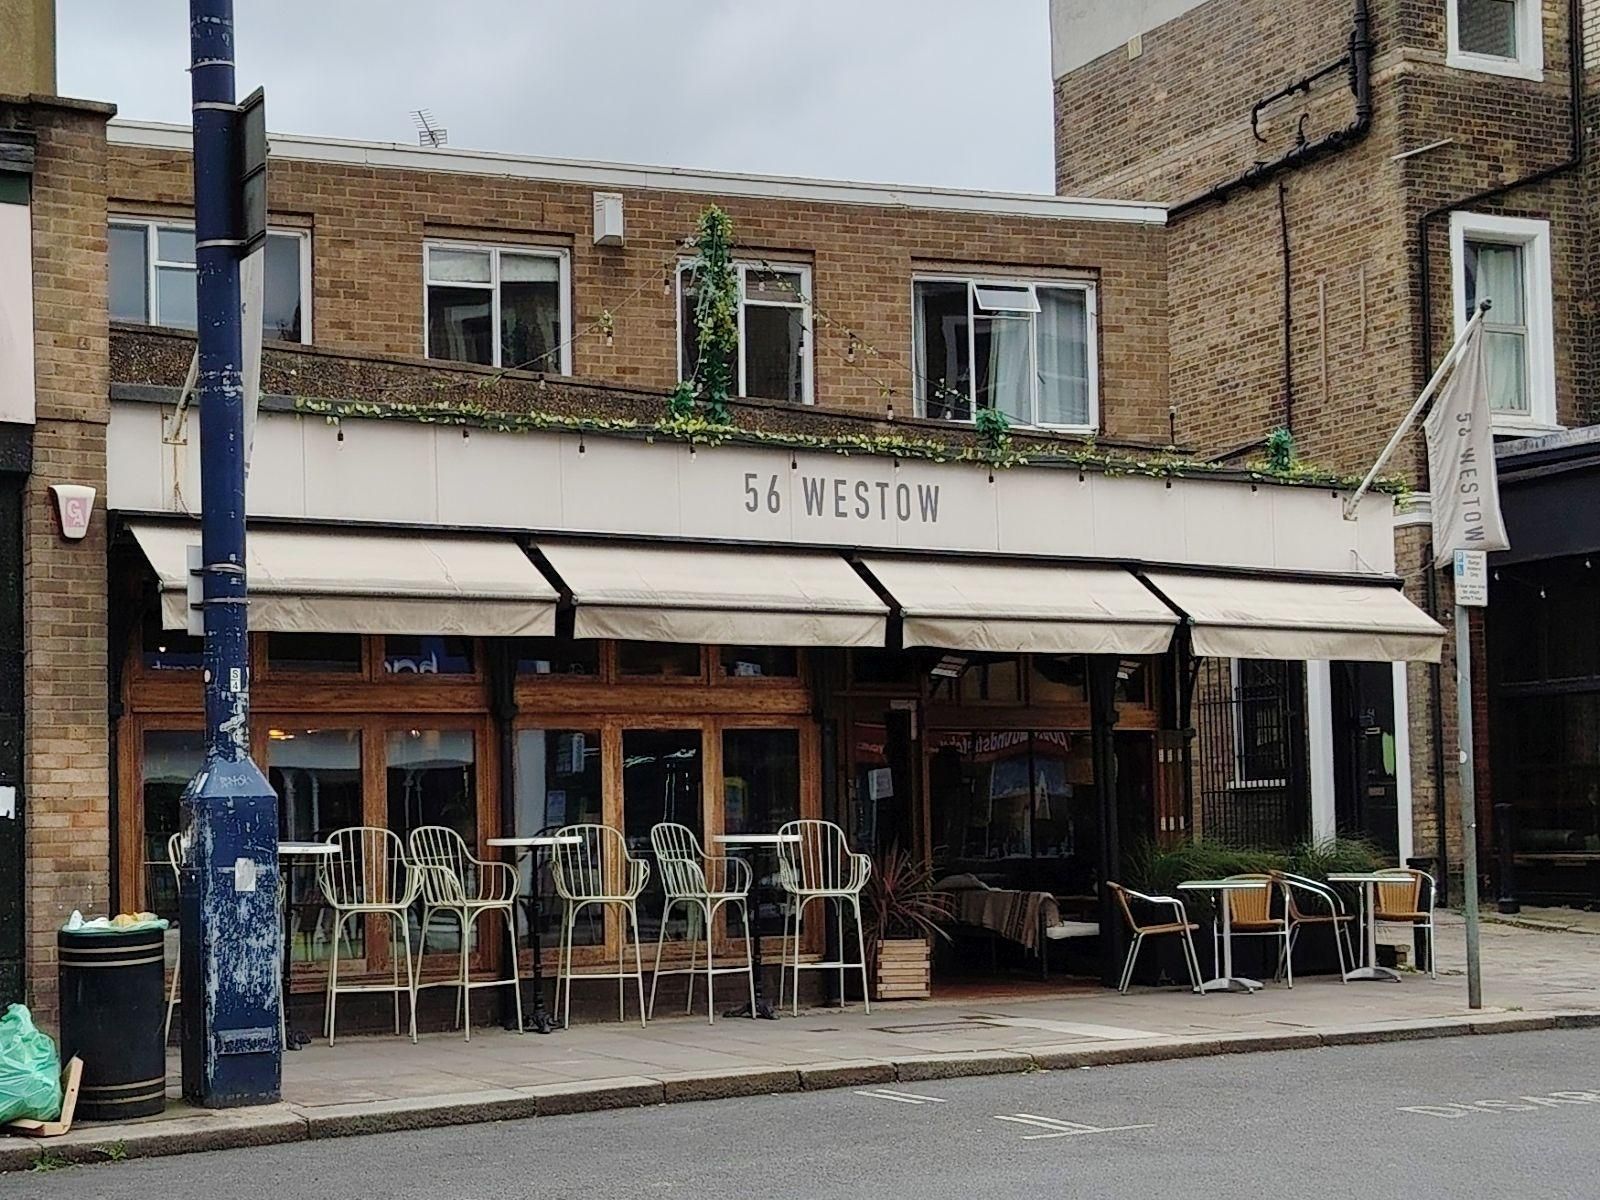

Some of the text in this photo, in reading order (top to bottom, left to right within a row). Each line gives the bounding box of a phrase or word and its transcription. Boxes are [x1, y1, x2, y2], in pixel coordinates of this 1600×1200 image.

[744, 473, 940, 523] 56 WESTOW
[1458, 447, 1485, 543] WESTOW
[232, 669, 239, 679] S
[232, 681, 239, 691] 4
